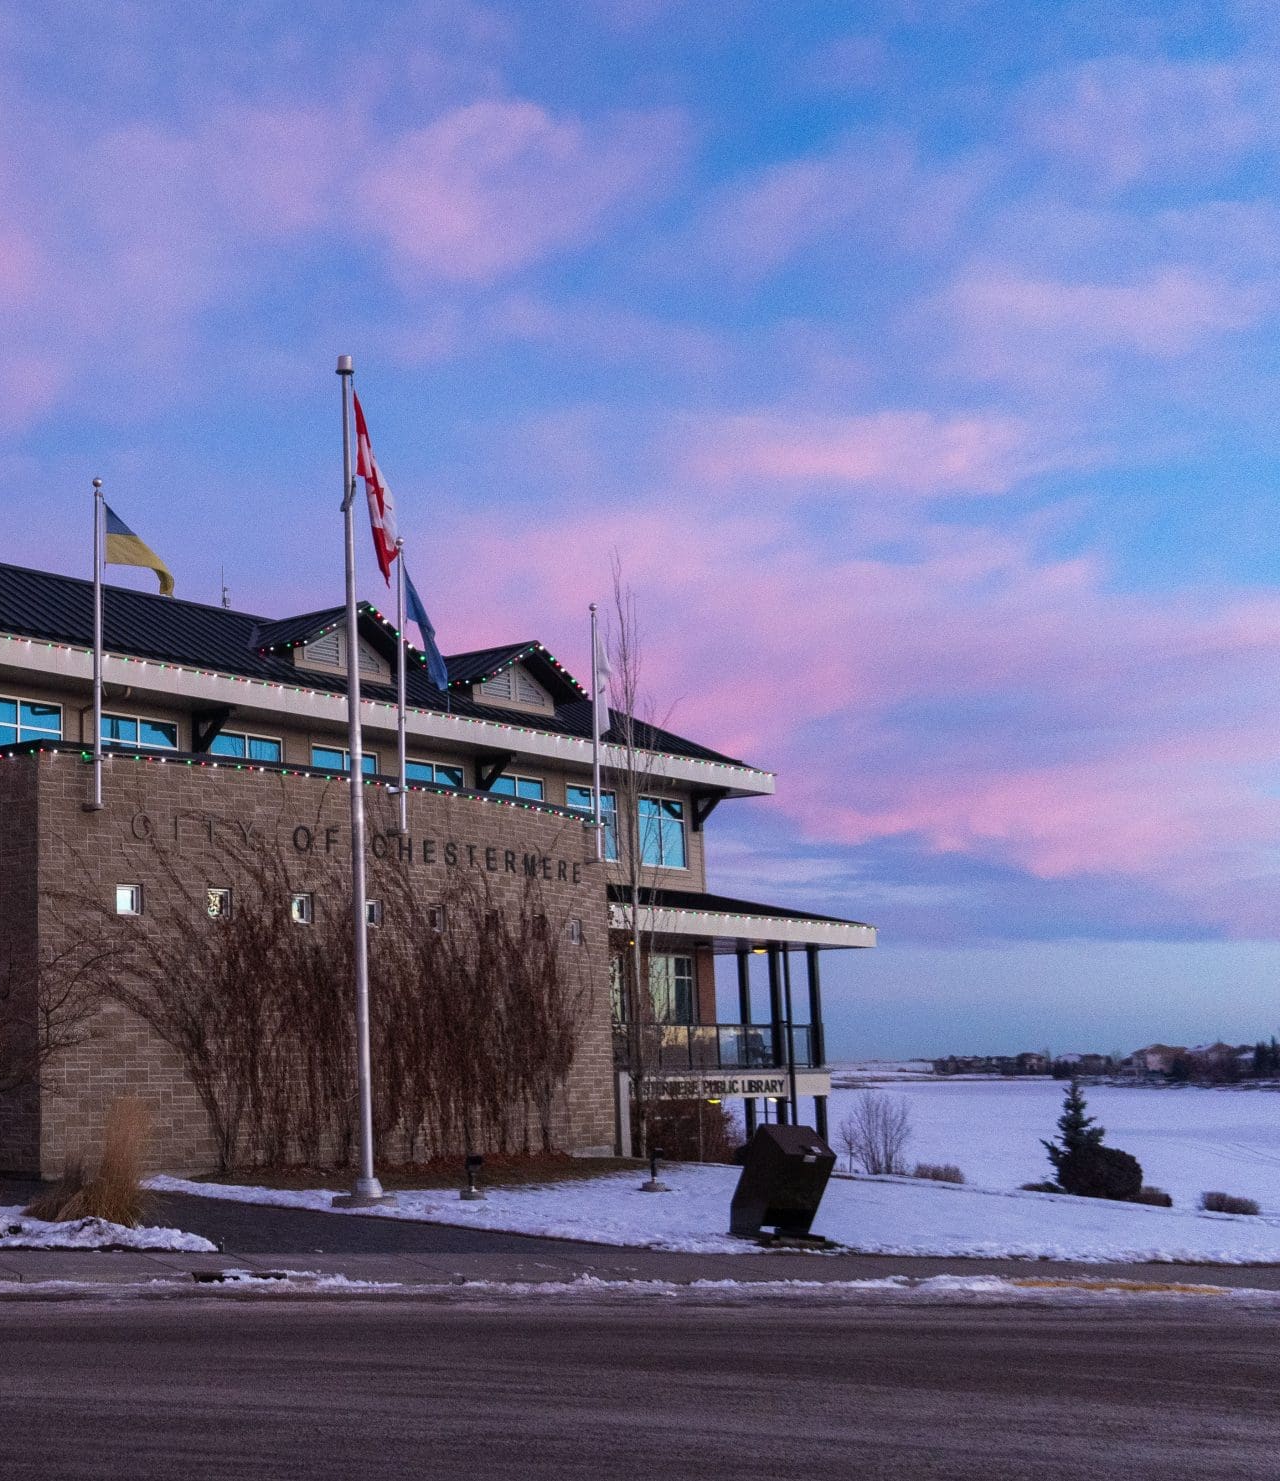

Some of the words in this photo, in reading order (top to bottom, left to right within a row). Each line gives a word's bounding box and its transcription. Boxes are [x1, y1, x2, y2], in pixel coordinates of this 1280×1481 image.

[292, 825, 340, 853] OF
[371, 833, 582, 884] CHESTERMERE
[704, 1080, 739, 1094] PUBLIC
[741, 1079, 785, 1093] LIBRARY
